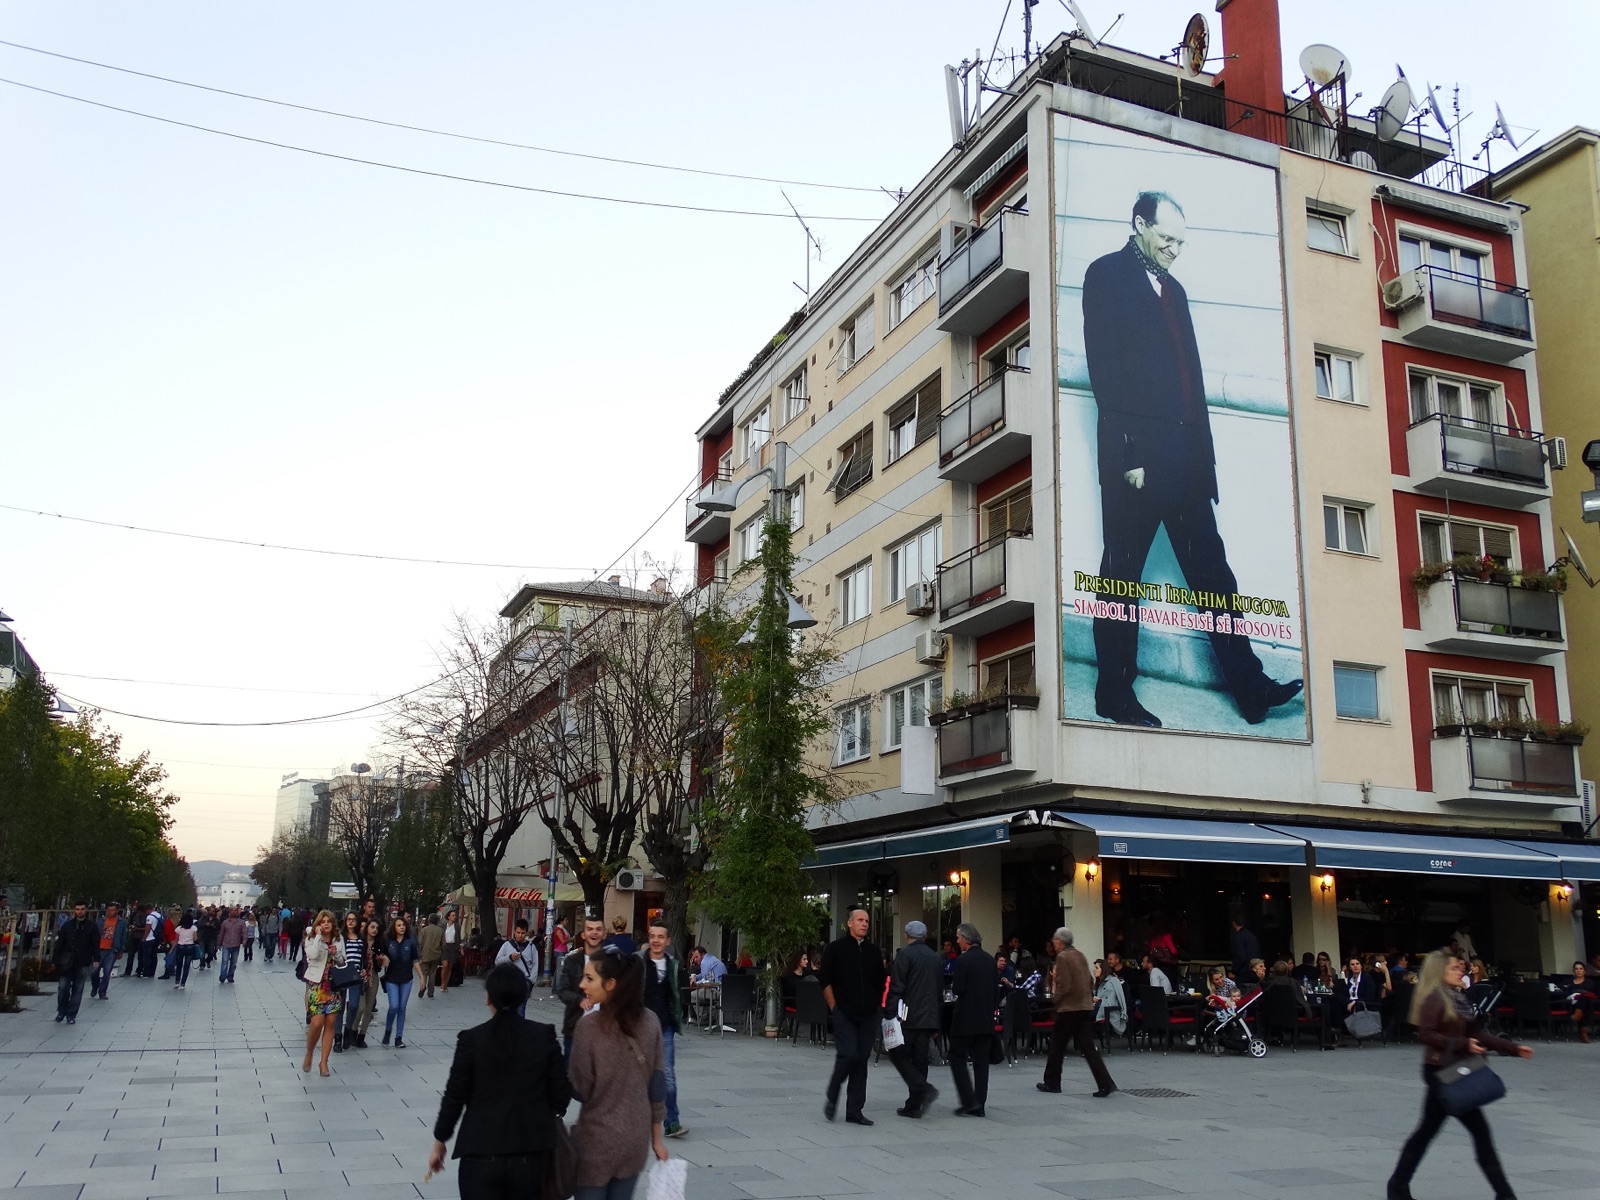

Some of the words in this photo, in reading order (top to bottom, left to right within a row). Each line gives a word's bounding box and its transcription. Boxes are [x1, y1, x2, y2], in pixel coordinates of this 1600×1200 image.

[1074, 571, 1162, 602] PRESIDENTI
[1165, 583, 1228, 610] IBRAHIM
[1231, 592, 1290, 617] RUGOVA
[1074, 599, 1127, 621] SIMBOL
[1129, 604, 1137, 622] I
[1140, 607, 1214, 632] PAVARËSISË
[1217, 613, 1231, 633] SË
[1234, 618, 1292, 640] KOSOVËS
